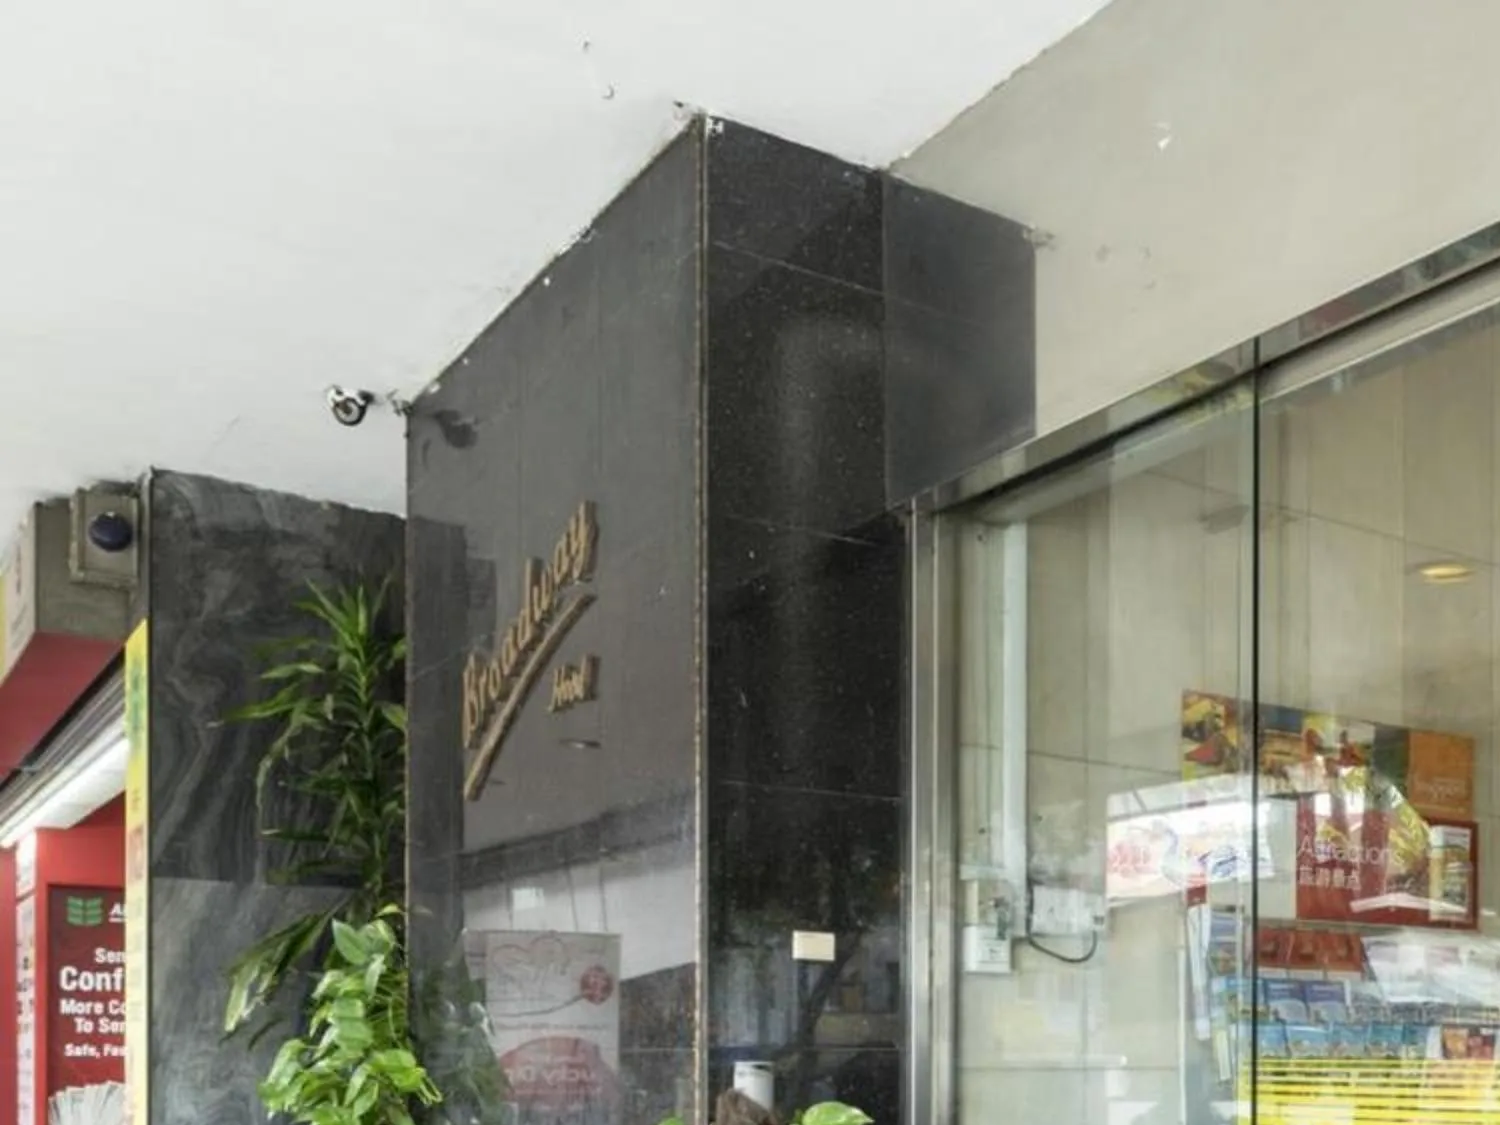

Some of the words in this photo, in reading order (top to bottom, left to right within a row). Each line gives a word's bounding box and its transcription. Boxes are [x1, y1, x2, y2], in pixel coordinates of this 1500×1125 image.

[463, 499, 598, 748] Broadway
[1297, 833, 1406, 866] Attractions
[60, 966, 124, 991] Conf
[60, 999, 104, 1014] More
[74, 1017, 94, 1033] To
